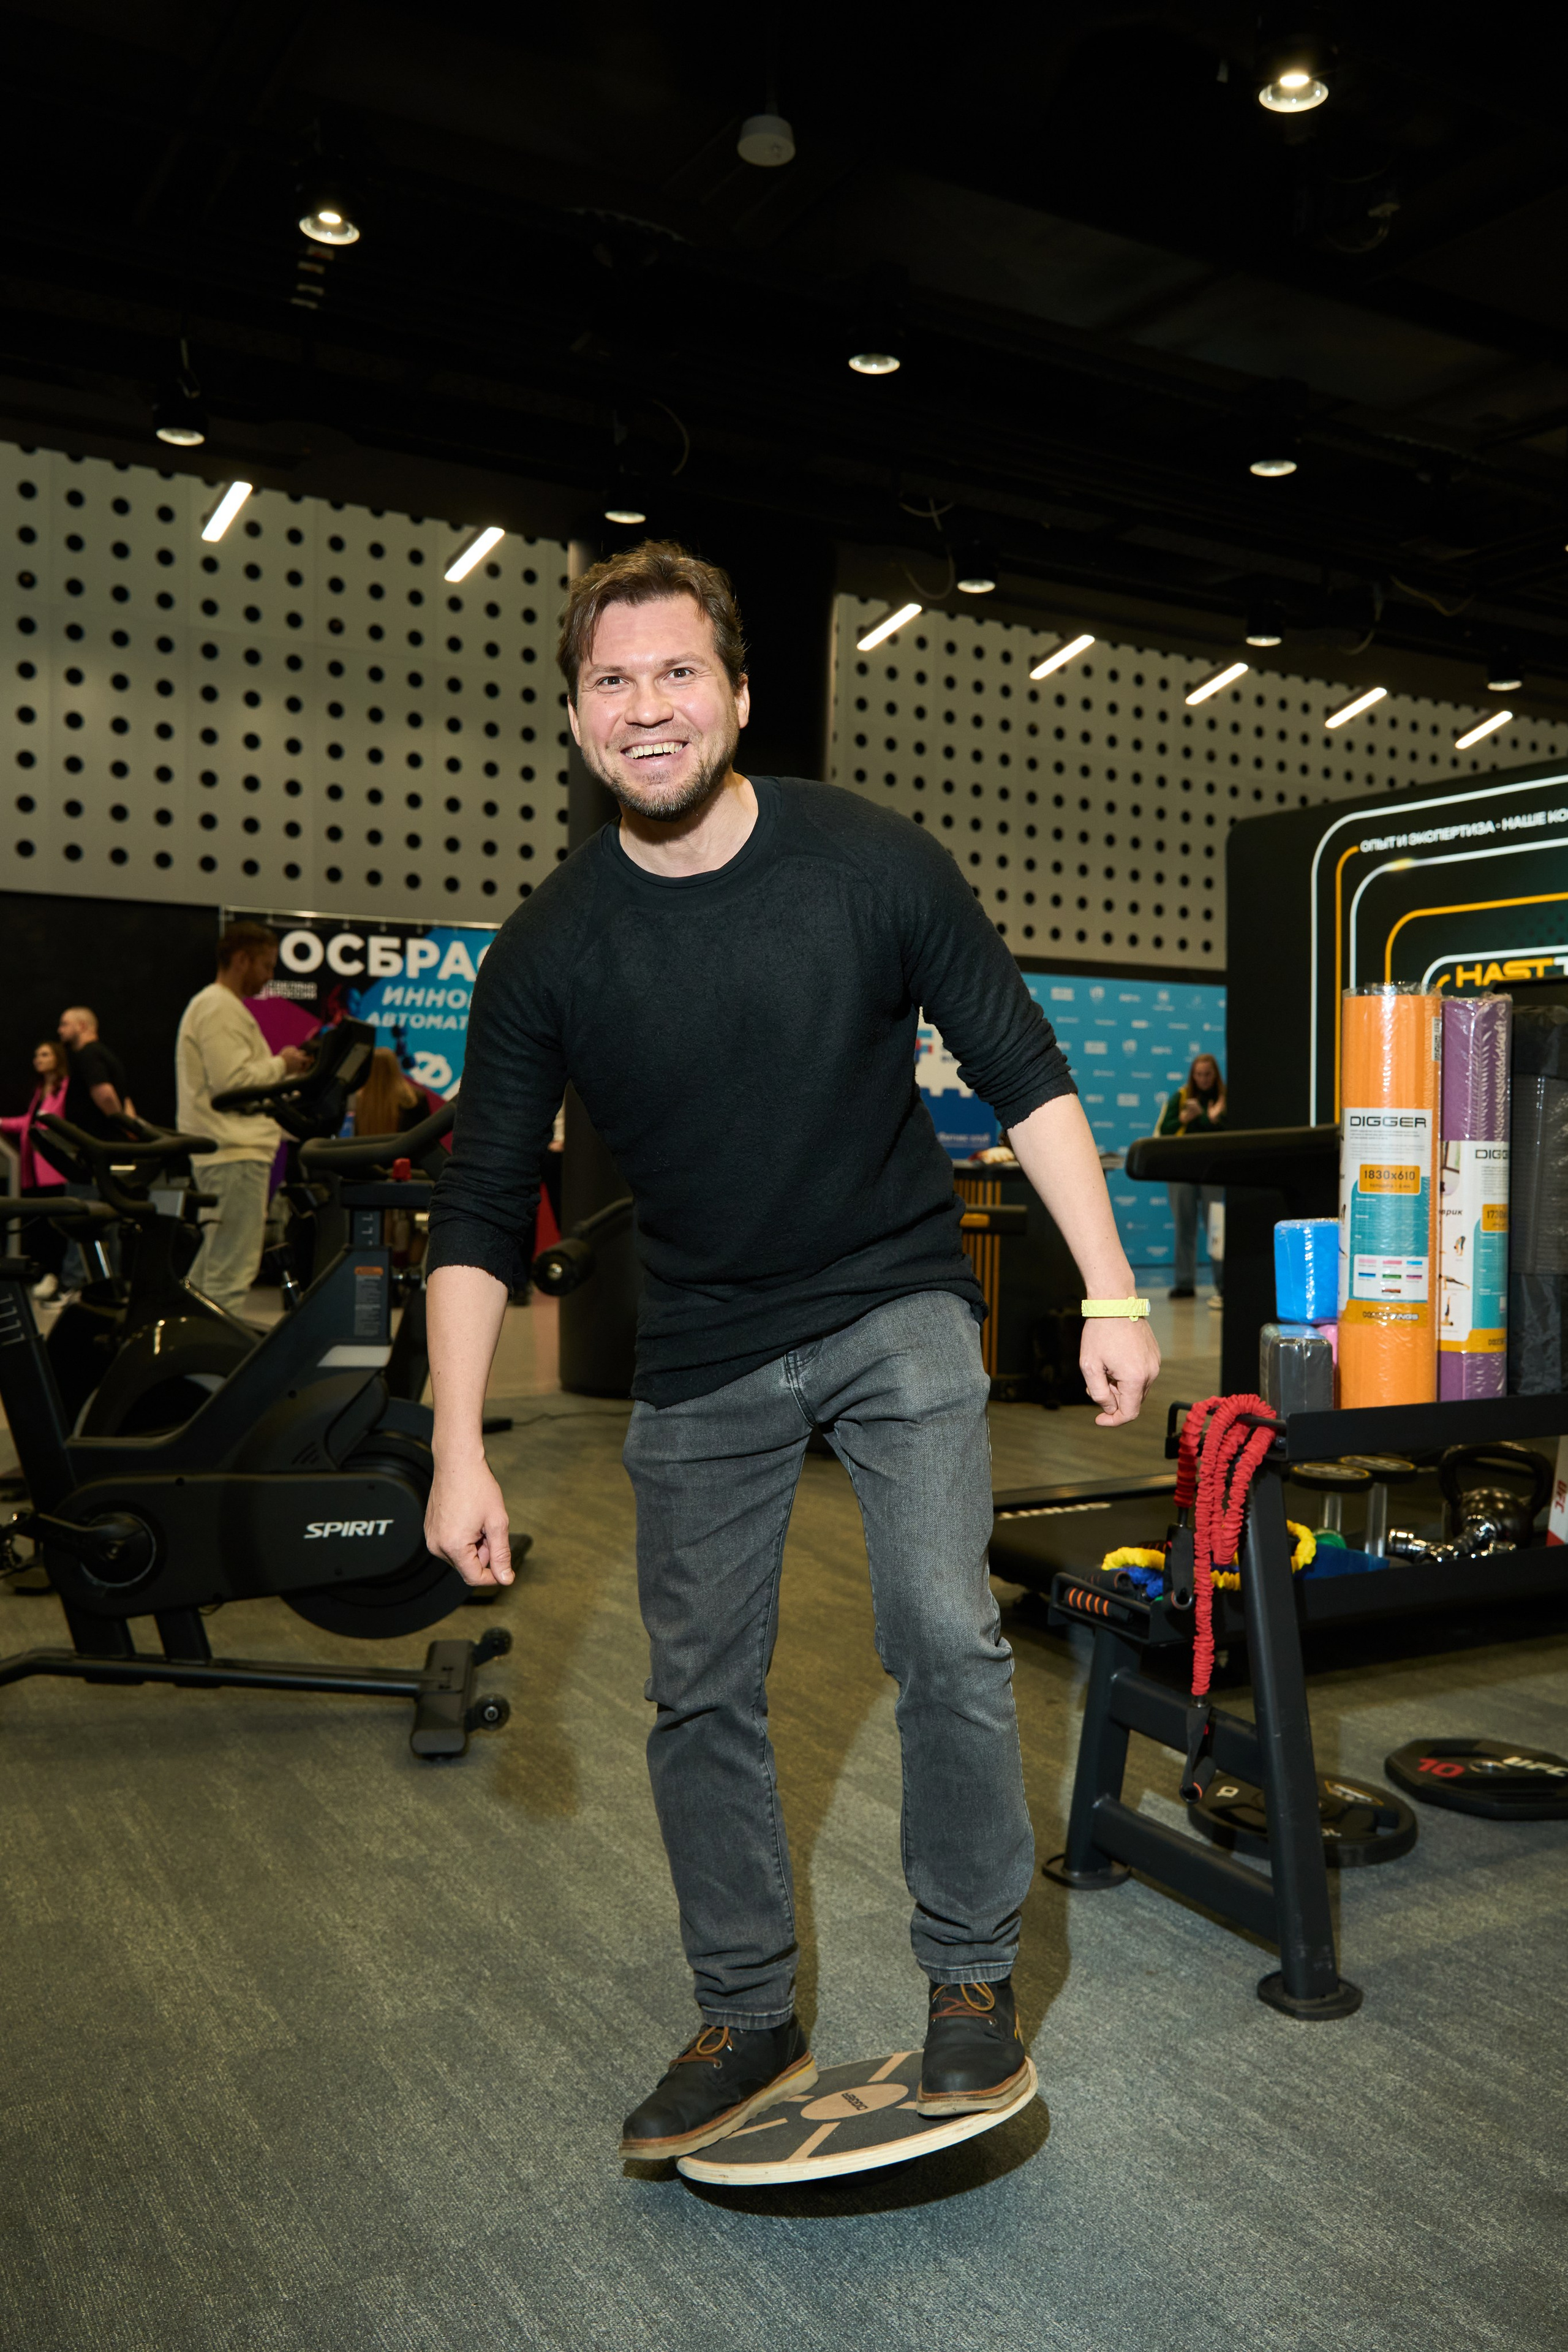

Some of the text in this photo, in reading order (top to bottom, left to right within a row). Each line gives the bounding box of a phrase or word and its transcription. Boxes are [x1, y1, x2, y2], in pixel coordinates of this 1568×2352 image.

[1360, 808, 1568, 853] ОПЫТ И ЭКСПЕРТИЗА НАШЕ КО
[279, 930, 490, 982] ОСБРА
[382, 986, 472, 1009] ИННО
[1349, 1116, 1426, 1128] DIGGER
[303, 1519, 394, 1539] SPIRIT
[1417, 1758, 1465, 1778] 10
